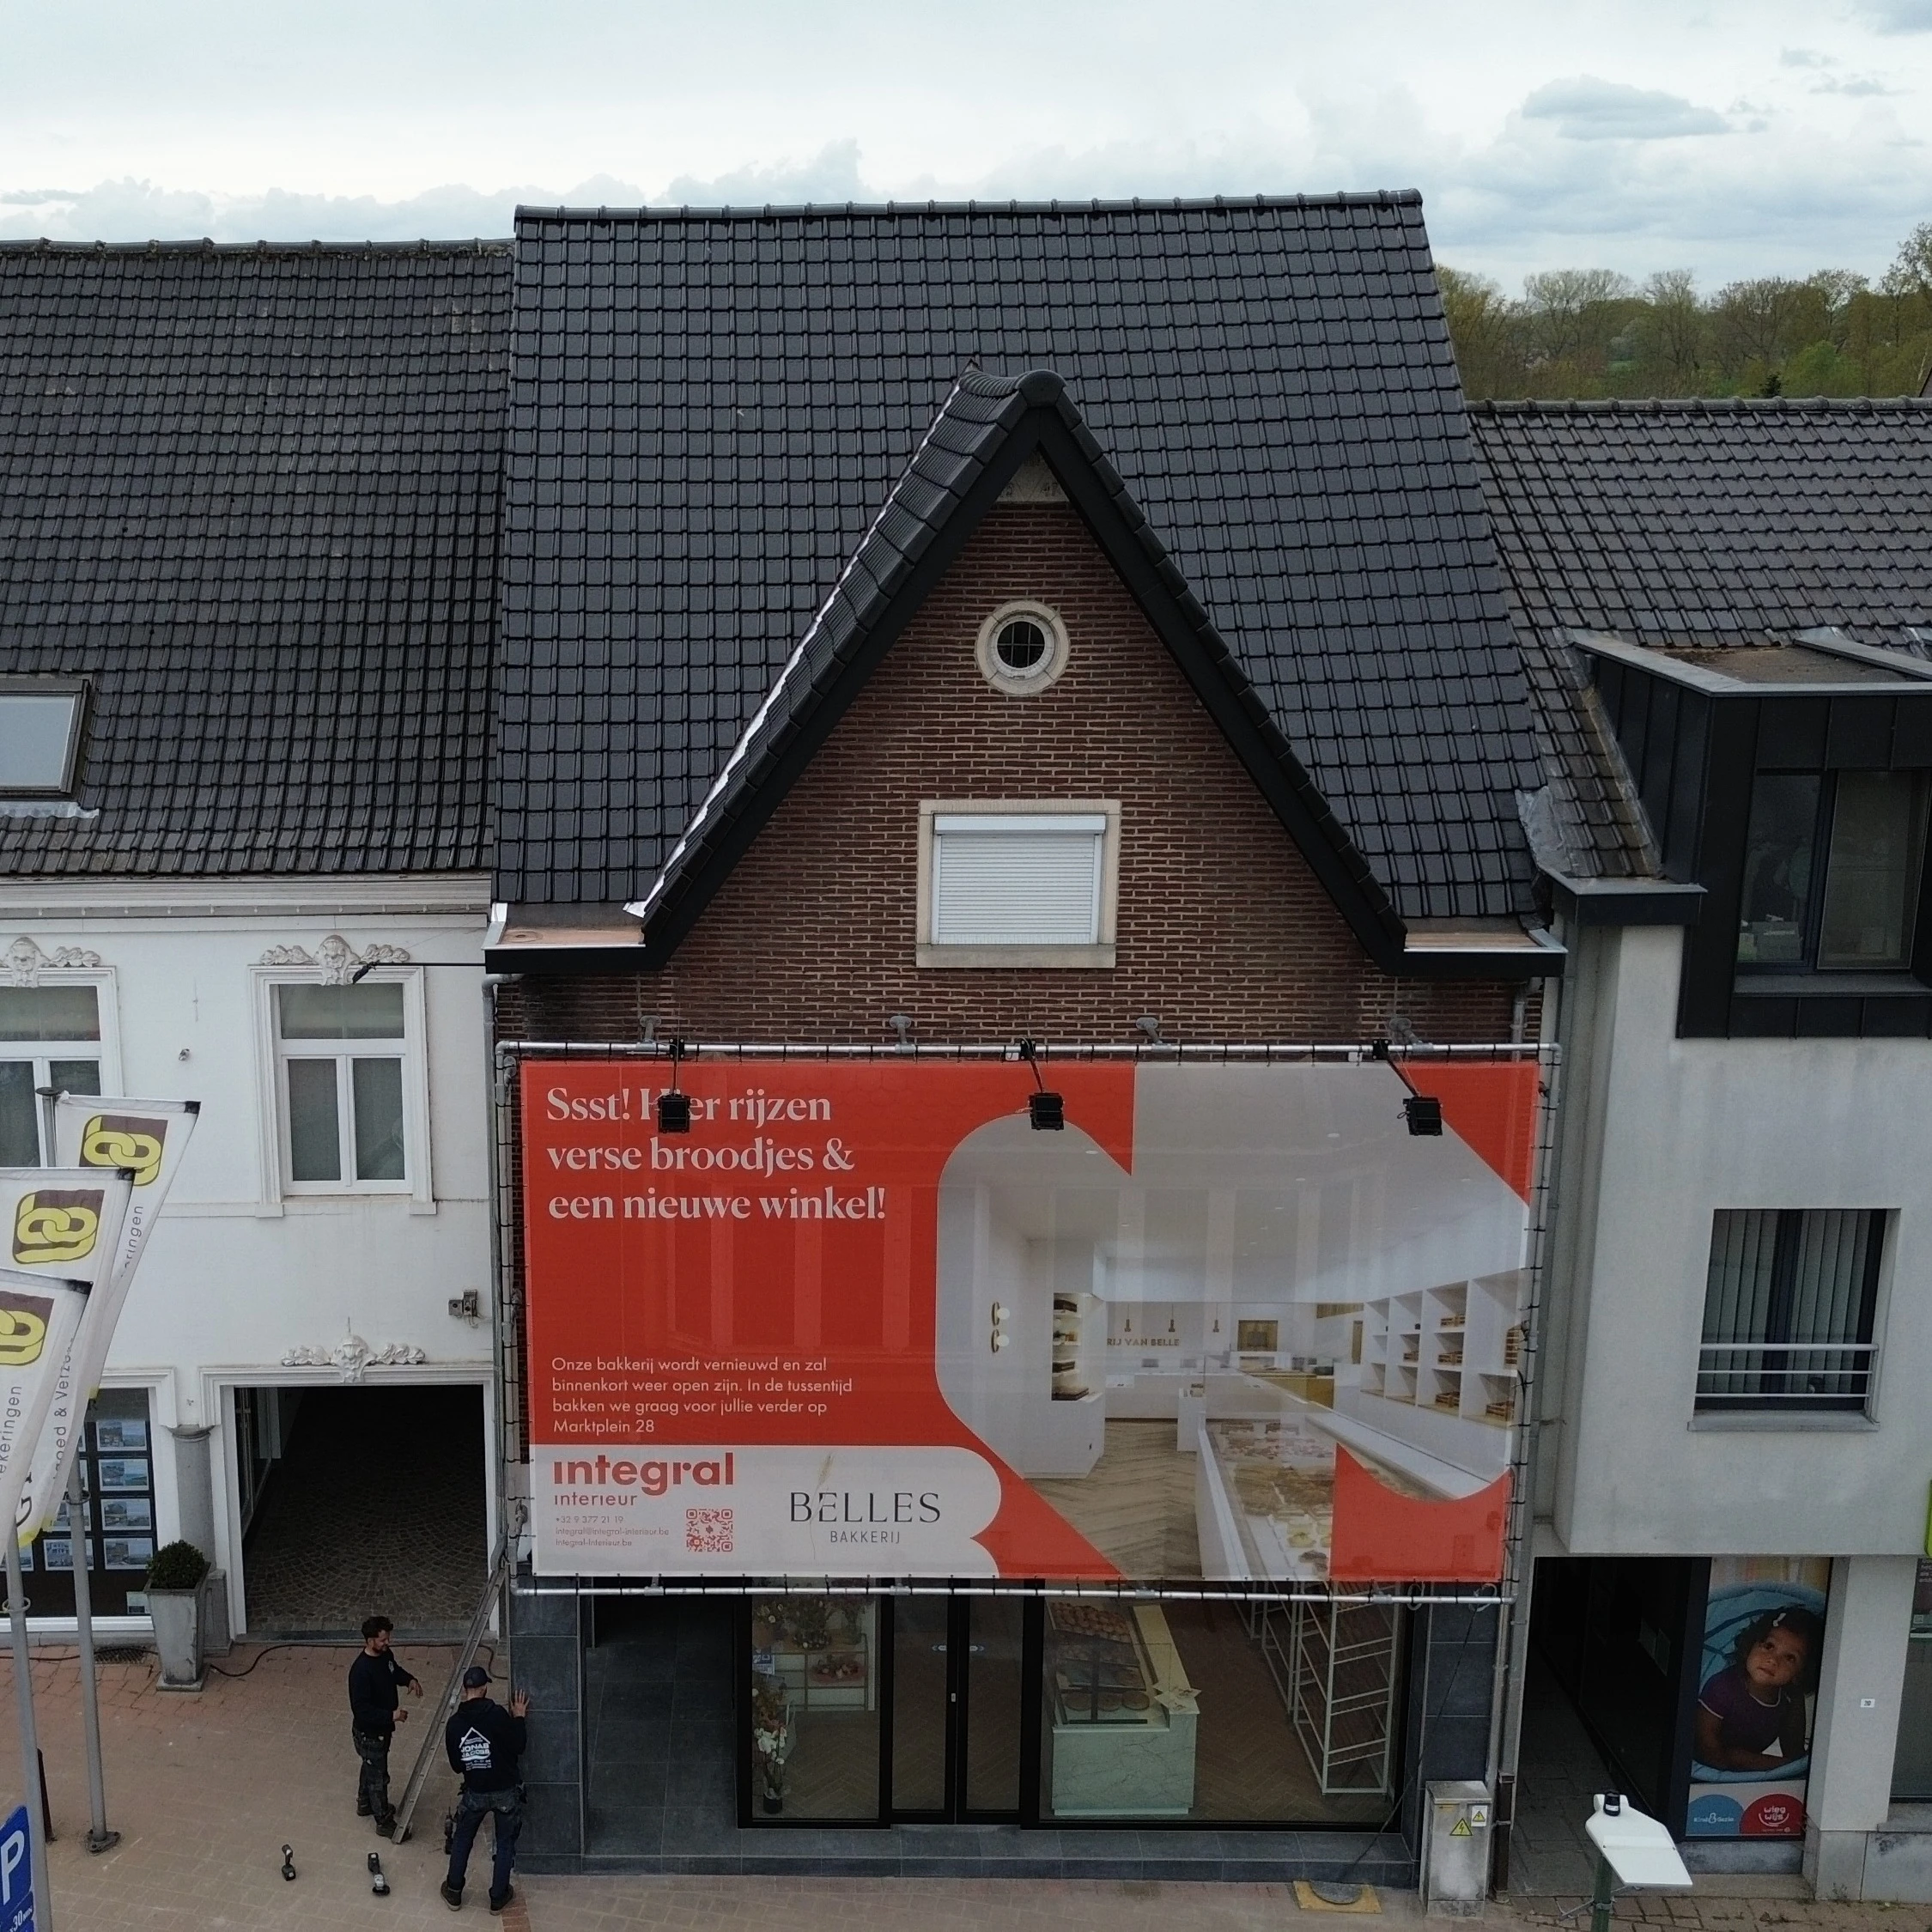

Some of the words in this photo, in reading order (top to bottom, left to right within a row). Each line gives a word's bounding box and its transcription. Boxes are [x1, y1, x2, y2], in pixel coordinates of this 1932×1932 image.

[547, 1087, 630, 1121] Ssst!
[729, 1088, 831, 1129] rijzen
[546, 1146, 642, 1170] verse
[649, 1136, 814, 1178] broodjes
[822, 1137, 855, 1170] &
[548, 1196, 614, 1219] een
[623, 1187, 751, 1219] nieuwe
[758, 1185, 886, 1219] winkel!
[551, 1357, 592, 1371] Onze
[597, 1356, 654, 1375] bakkerij
[658, 1356, 701, 1371] wordt
[703, 1356, 779, 1371] vernieuwd
[782, 1361, 800, 1371] en
[805, 1357, 827, 1371] zal
[552, 1376, 629, 1392] binnenkort
[632, 1382, 668, 1392] weer
[672, 1381, 709, 1395] open
[714, 1378, 743, 1395] zijn.
[747, 1378, 760, 1392] In
[764, 1376, 784, 1392] de
[787, 1377, 853, 1396] tussentijd
[53, 1407, 67, 1418] &
[553, 1397, 605, 1413] bakken
[609, 1402, 631, 1413] we
[635, 1402, 679, 1416] graag
[683, 1402, 717, 1413] voor
[720, 1397, 753, 1416] jullie
[756, 1398, 804, 1413] verder
[807, 1402, 828, 1417] op
[553, 1418, 630, 1437] Marktplein
[635, 1419, 655, 1433] 28
[554, 1452, 734, 1497] integral
[555, 1492, 638, 1506] interieur
[790, 1492, 941, 1523] BELLES
[574, 1516, 580, 1524] 9
[582, 1516, 598, 1524] 377
[601, 1516, 610, 1524] 21
[615, 1516, 624, 1524] 19
[829, 1530, 900, 1545] BAKKERIJ
[1, 1830, 25, 1906] P
